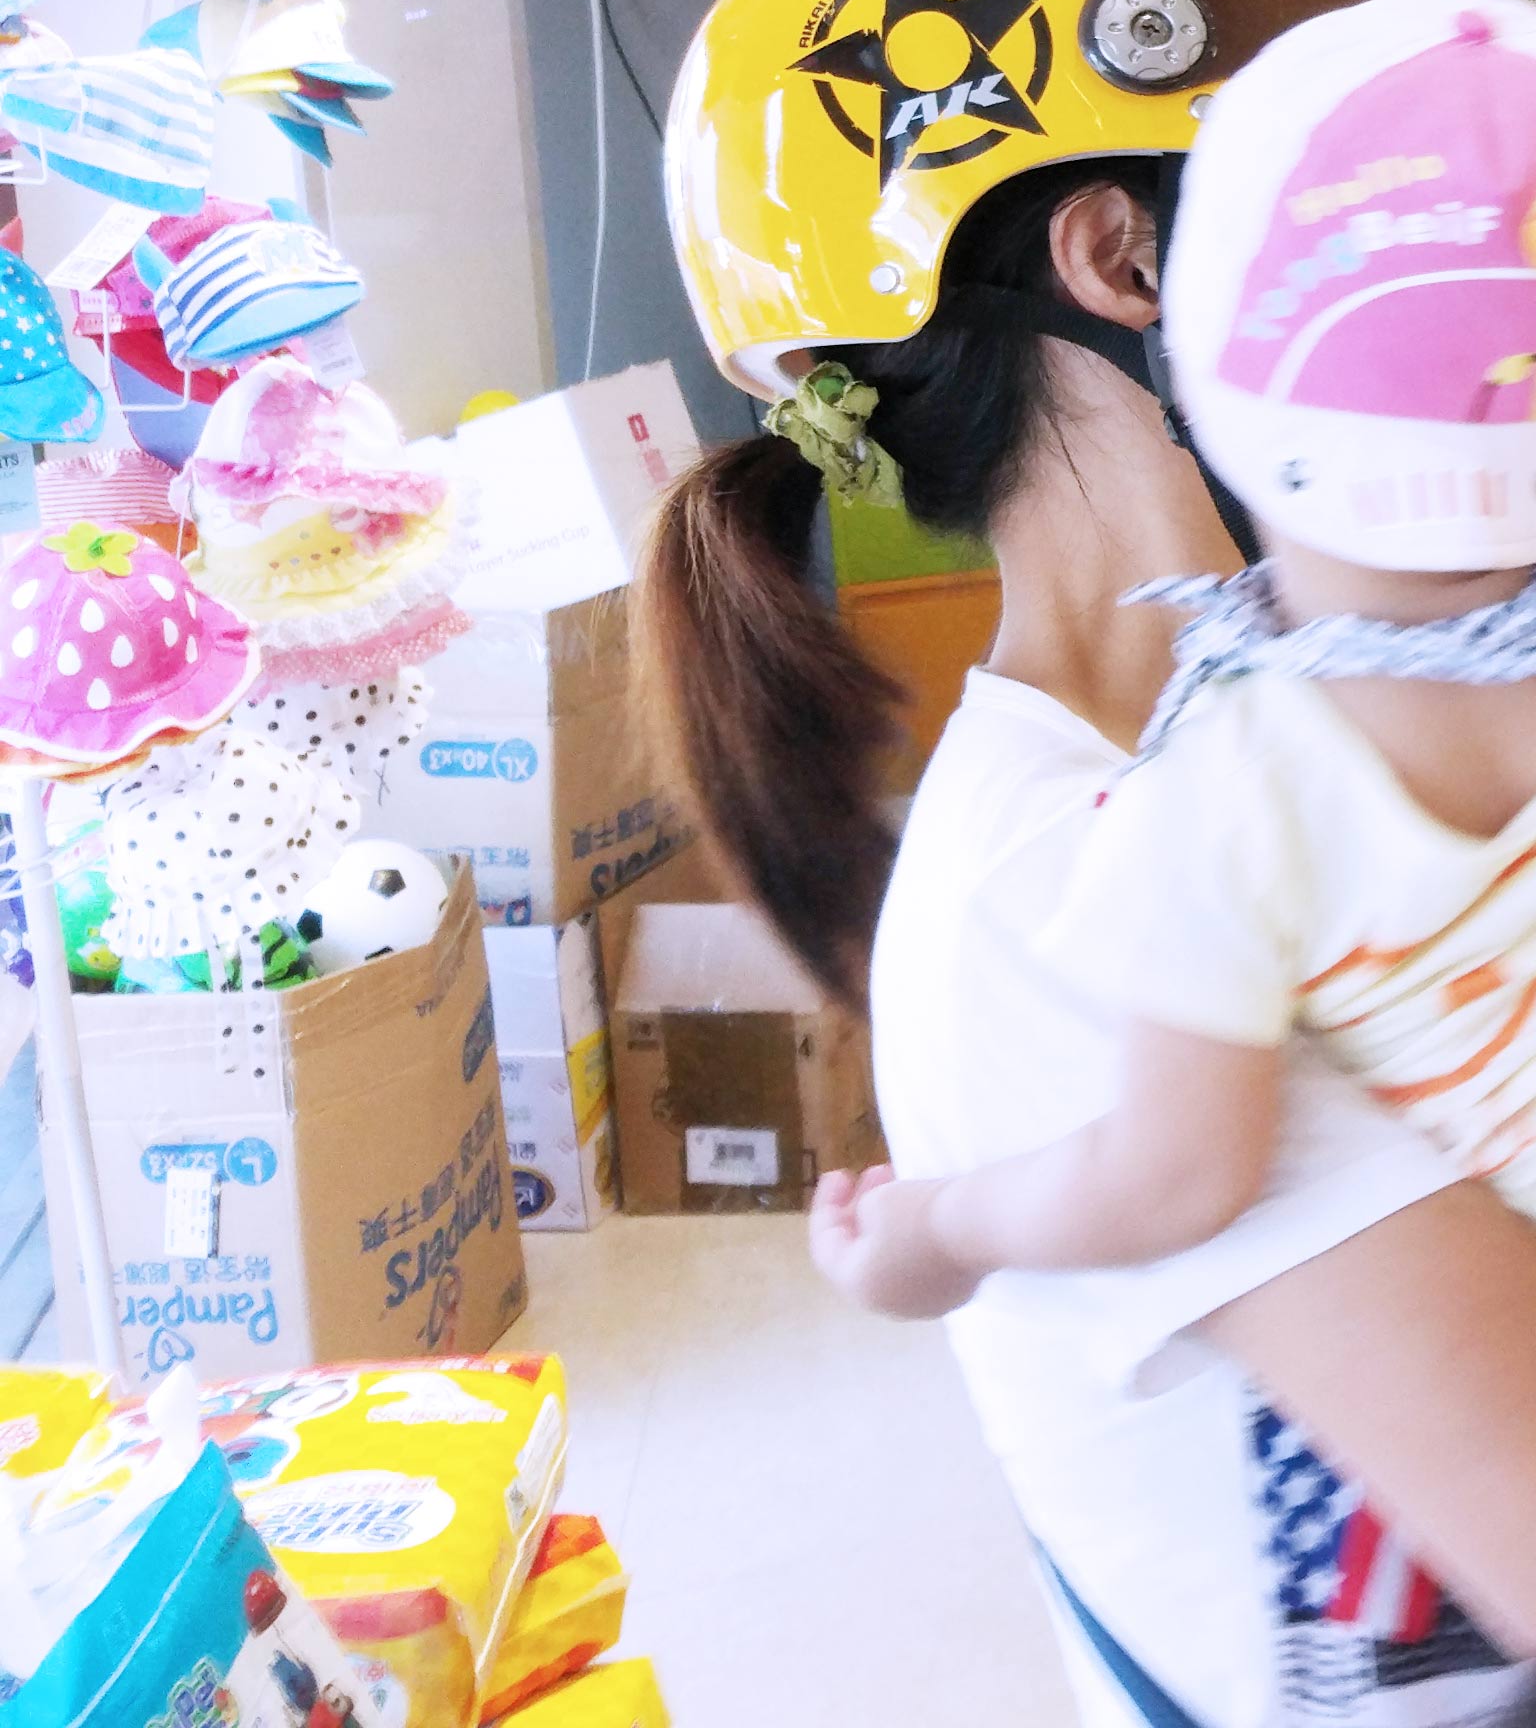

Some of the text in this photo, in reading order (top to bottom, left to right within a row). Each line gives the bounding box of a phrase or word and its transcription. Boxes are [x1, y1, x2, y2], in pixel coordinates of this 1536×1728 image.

[885, 71, 1012, 140] AK
[561, 524, 591, 546] Cup
[500, 756, 531, 779] XL
[240, 1155, 264, 1181] L
[118, 1284, 280, 1346] Pamper
